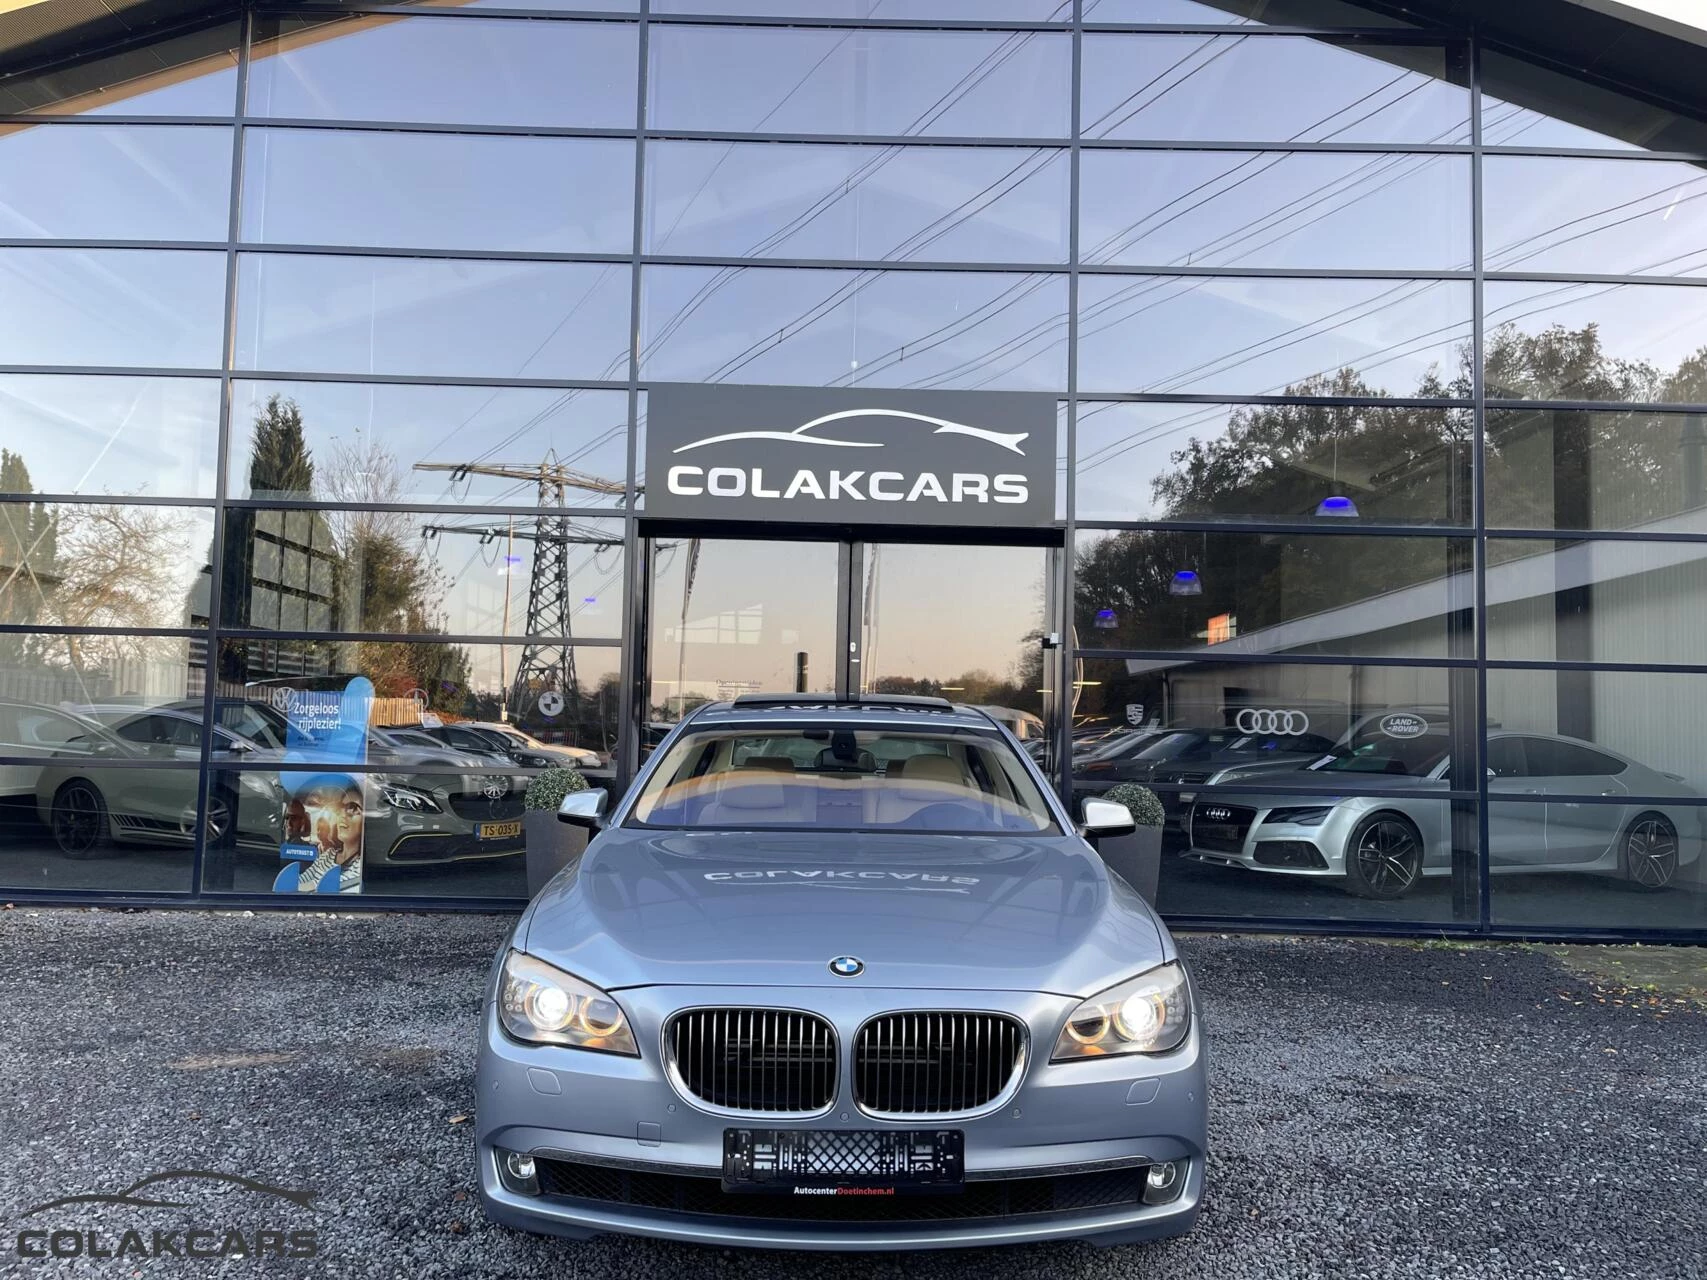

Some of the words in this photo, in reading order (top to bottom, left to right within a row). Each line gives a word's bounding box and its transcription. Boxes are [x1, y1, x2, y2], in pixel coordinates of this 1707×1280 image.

[667, 465, 1029, 504] COLAKCARS
[294, 702, 339, 718] Zorgeloos
[298, 717, 342, 732] rijplezier!
[793, 1185, 895, 1196] AutocenterDoetinchem.nl
